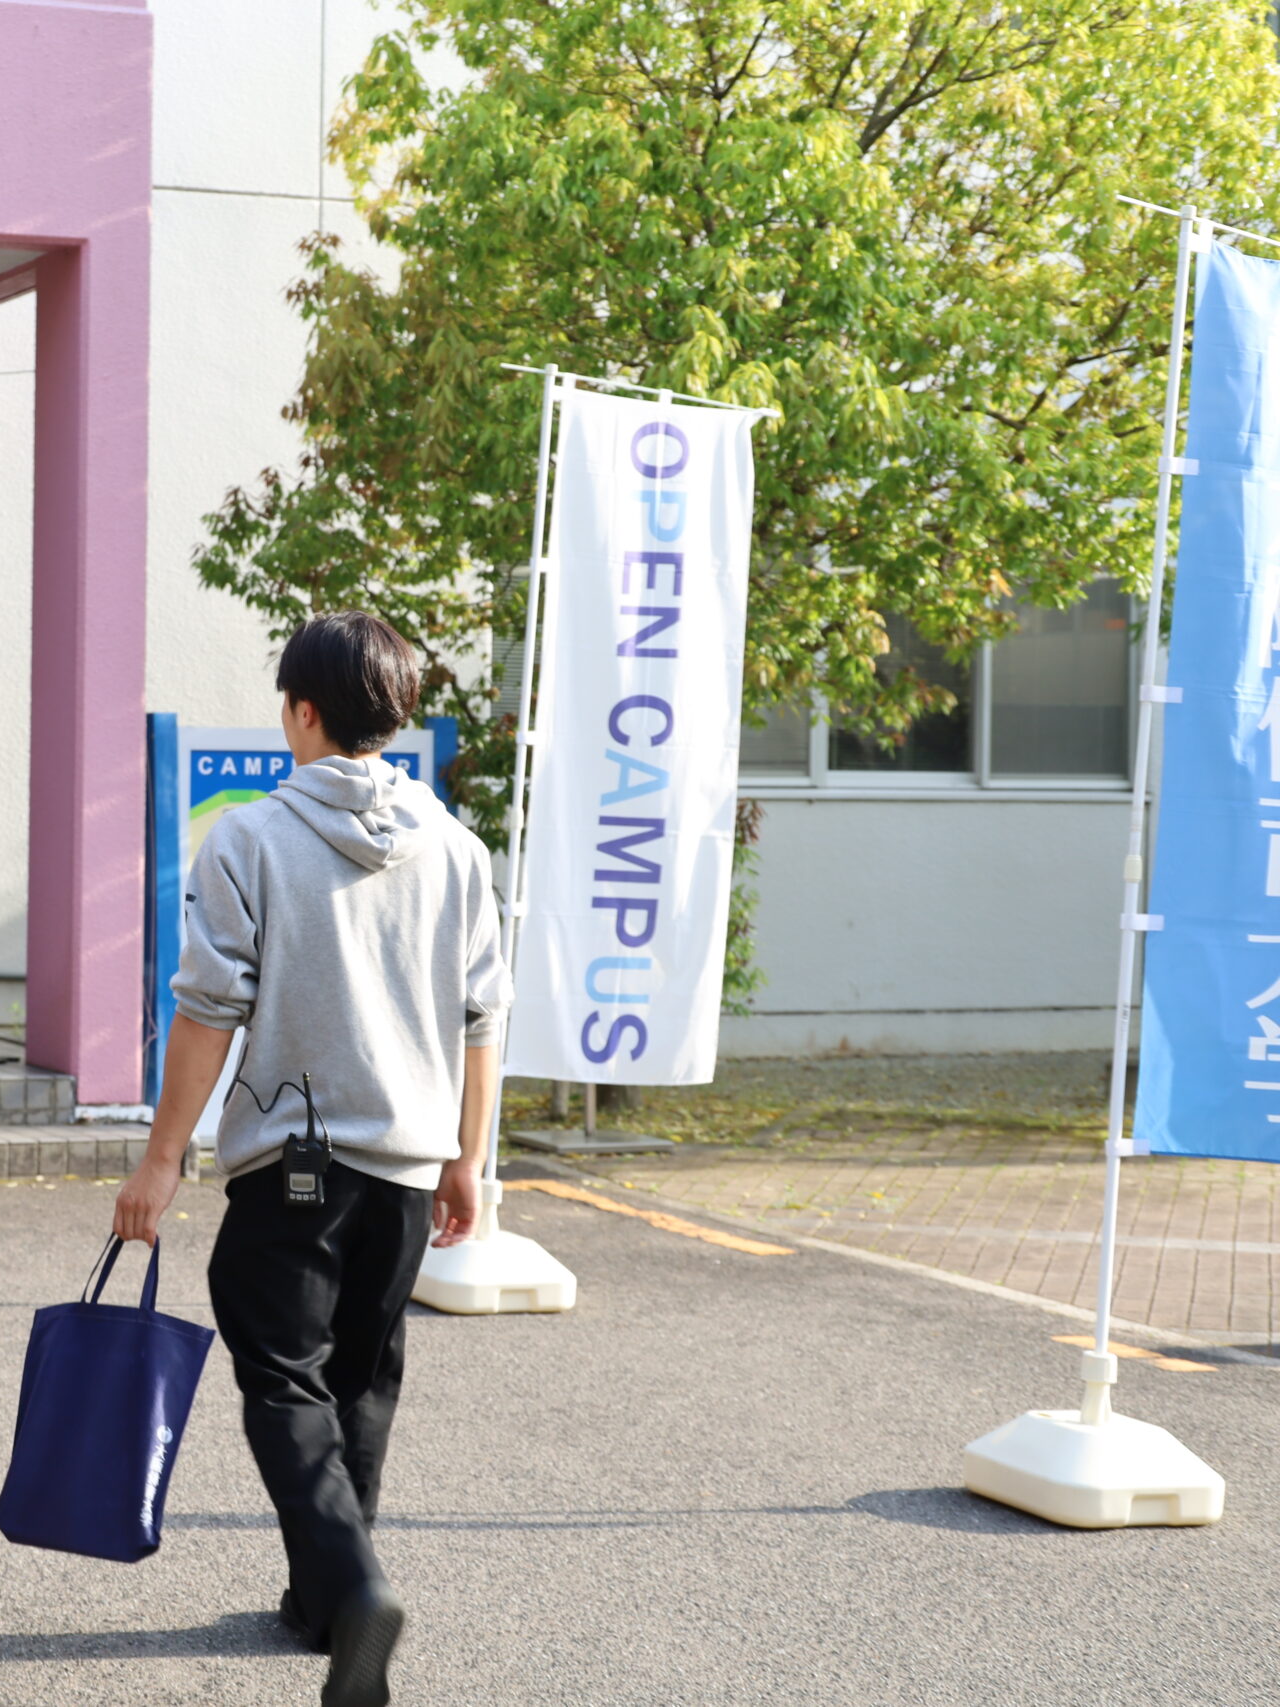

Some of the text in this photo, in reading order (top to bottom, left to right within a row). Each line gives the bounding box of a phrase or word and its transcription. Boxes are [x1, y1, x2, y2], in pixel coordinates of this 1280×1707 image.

[197, 756, 297, 776] CAMP
[580, 421, 690, 1065] OPEN CAMPUS
